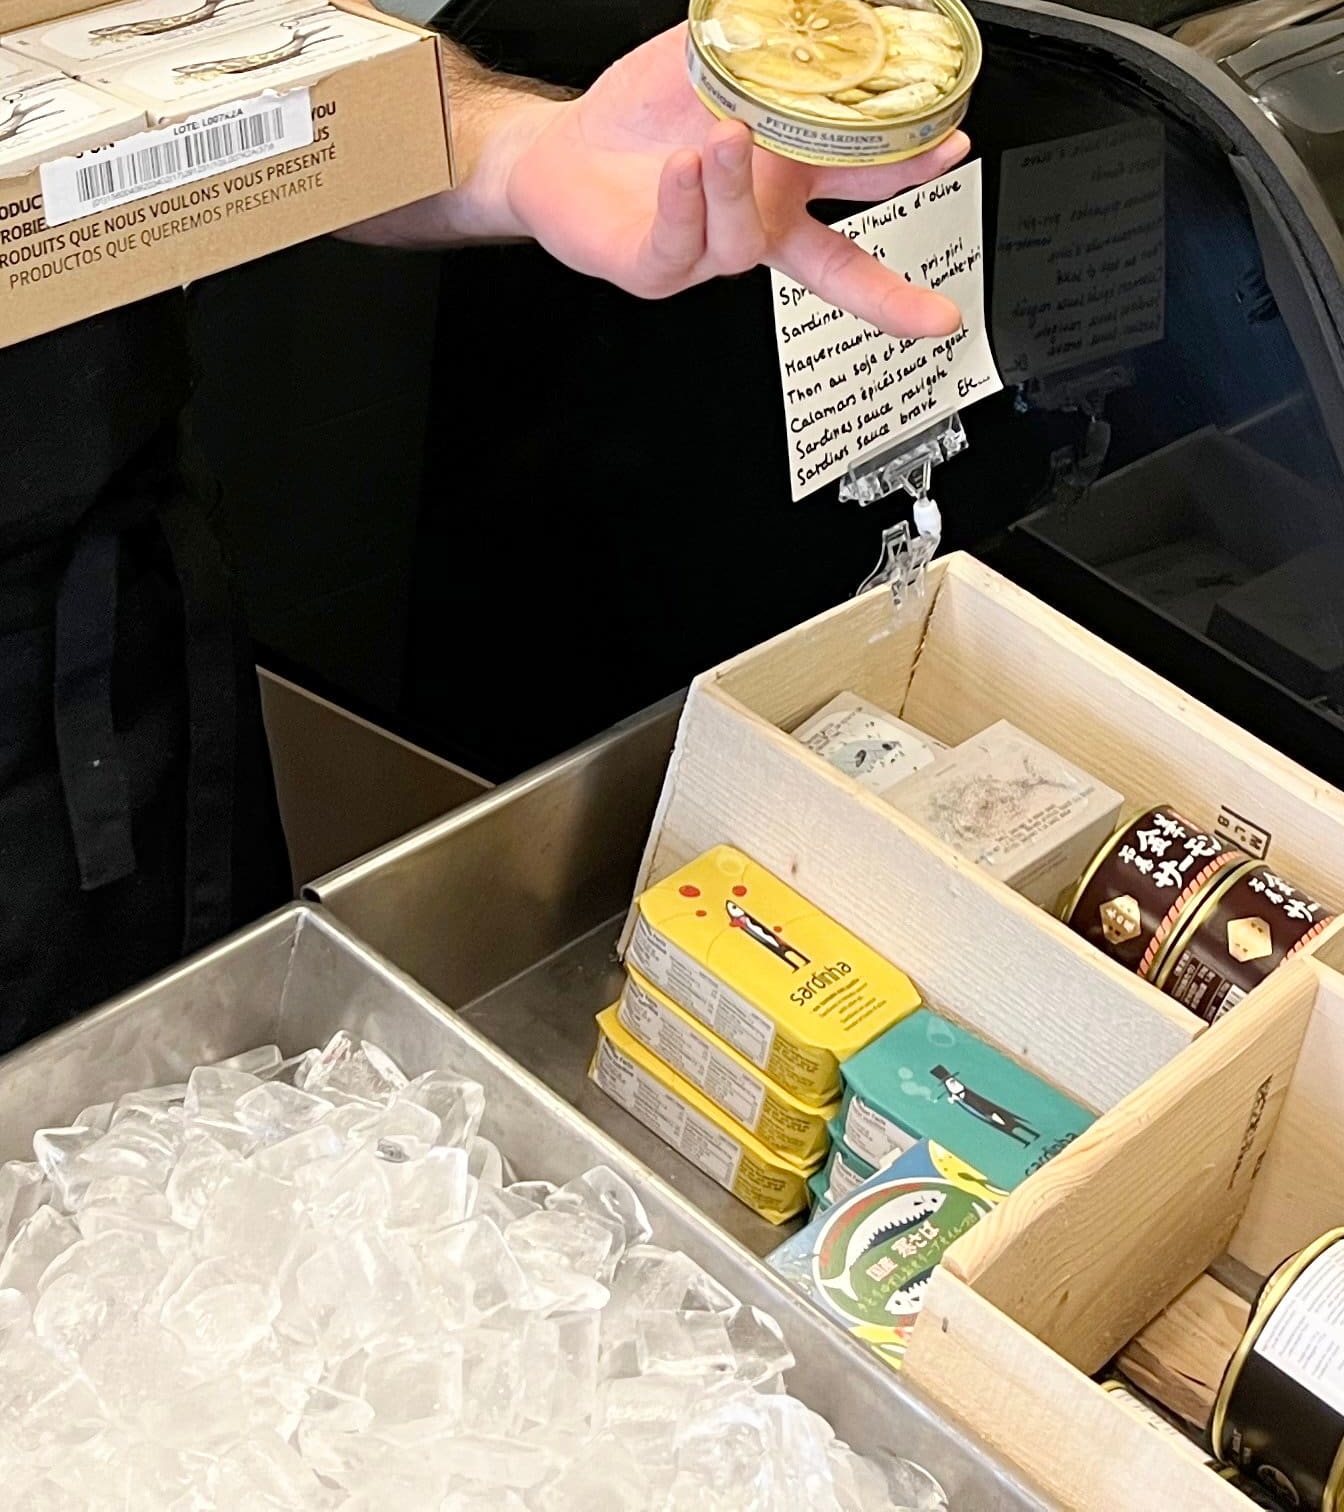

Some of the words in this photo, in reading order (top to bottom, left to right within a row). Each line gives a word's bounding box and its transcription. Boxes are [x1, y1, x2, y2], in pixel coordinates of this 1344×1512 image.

[819, 131, 884, 144] SARDINES
[69, 223, 102, 248] QUE
[104, 209, 146, 235] NOUS
[149, 186, 221, 220] VOULONS
[223, 170, 264, 194] VOUS
[266, 142, 338, 181] PRESENTÉ
[914, 180, 962, 209] d'olive
[9, 246, 103, 290] PRODUCTOS
[105, 237, 138, 261] QUE
[140, 208, 223, 247] QUEREMOS
[225, 171, 324, 218] PRESENTARTE
[779, 285, 812, 307] Spr
[781, 306, 845, 344] Sardines
[787, 381, 822, 405] Thon
[829, 372, 848, 388] au
[853, 353, 878, 377] soja
[883, 342, 896, 362] et
[896, 355, 928, 383] sauce
[796, 422, 853, 460] Sardines
[857, 401, 894, 430] sauce
[797, 443, 849, 486] Sardines
[857, 421, 891, 451] sauce
